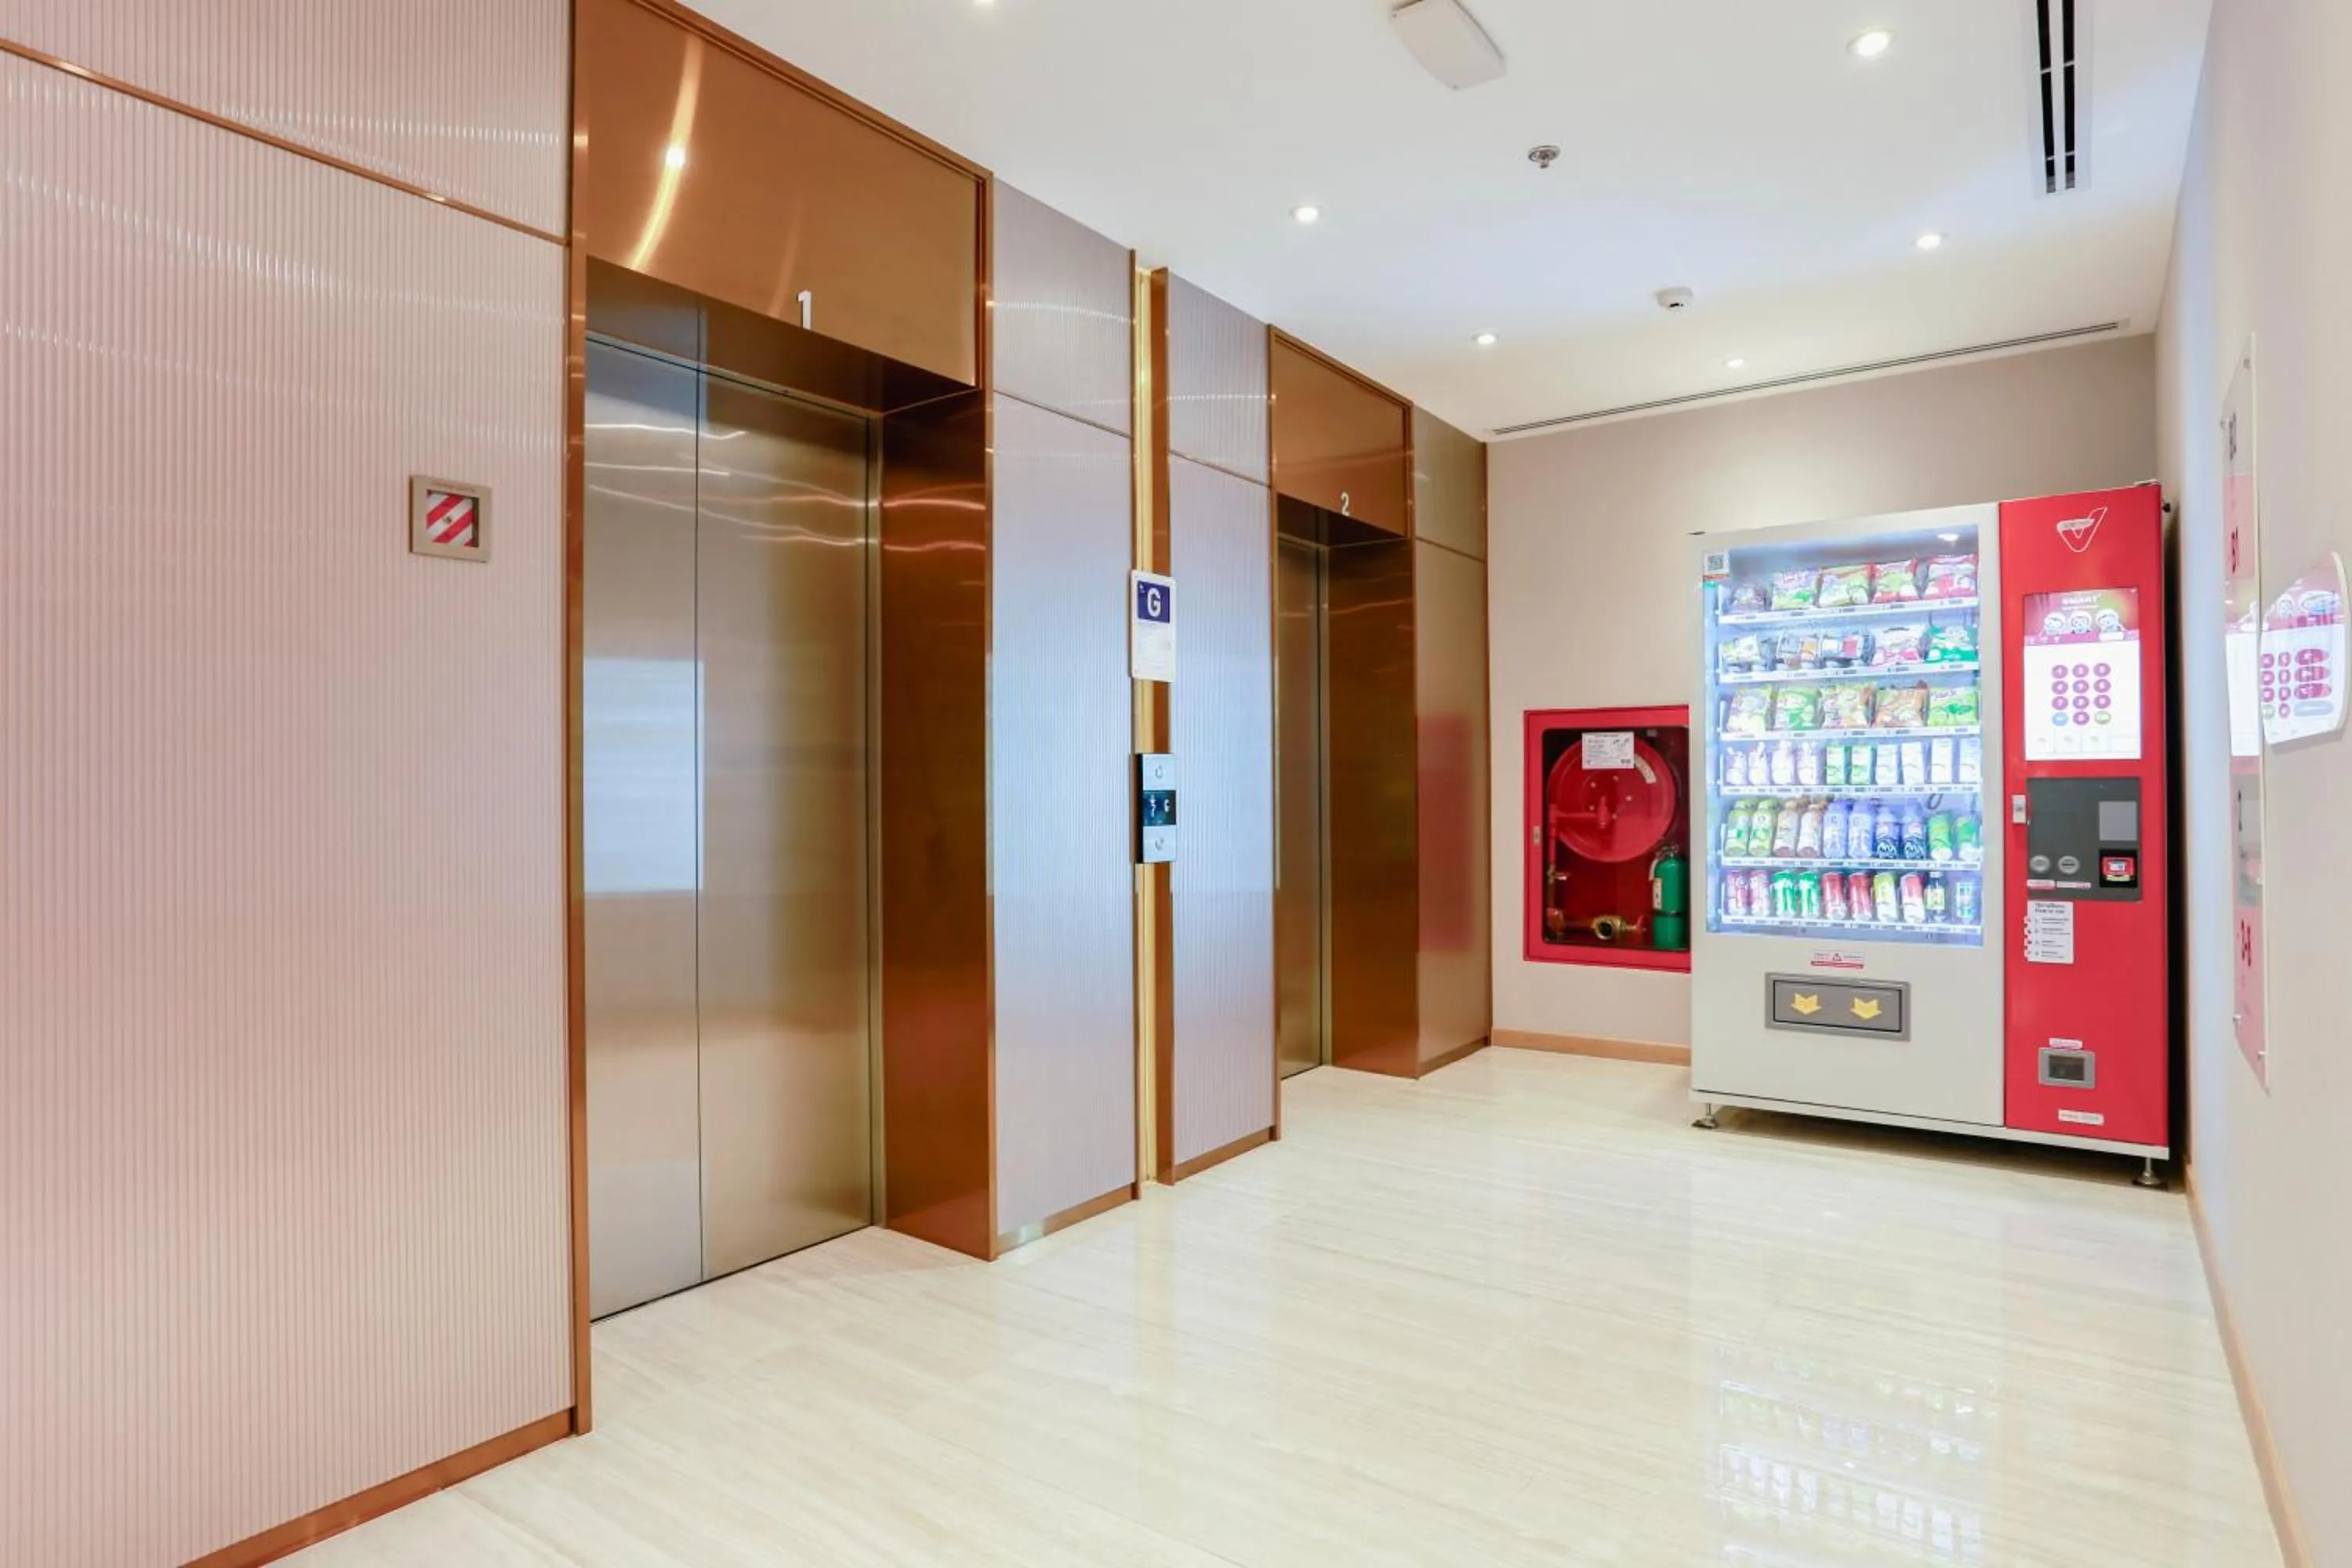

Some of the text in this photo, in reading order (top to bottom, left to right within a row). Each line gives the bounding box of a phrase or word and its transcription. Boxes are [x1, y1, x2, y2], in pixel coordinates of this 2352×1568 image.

[798, 290, 811, 330] 1
[1341, 492, 1350, 516] 2
[1147, 587, 1161, 617] G
